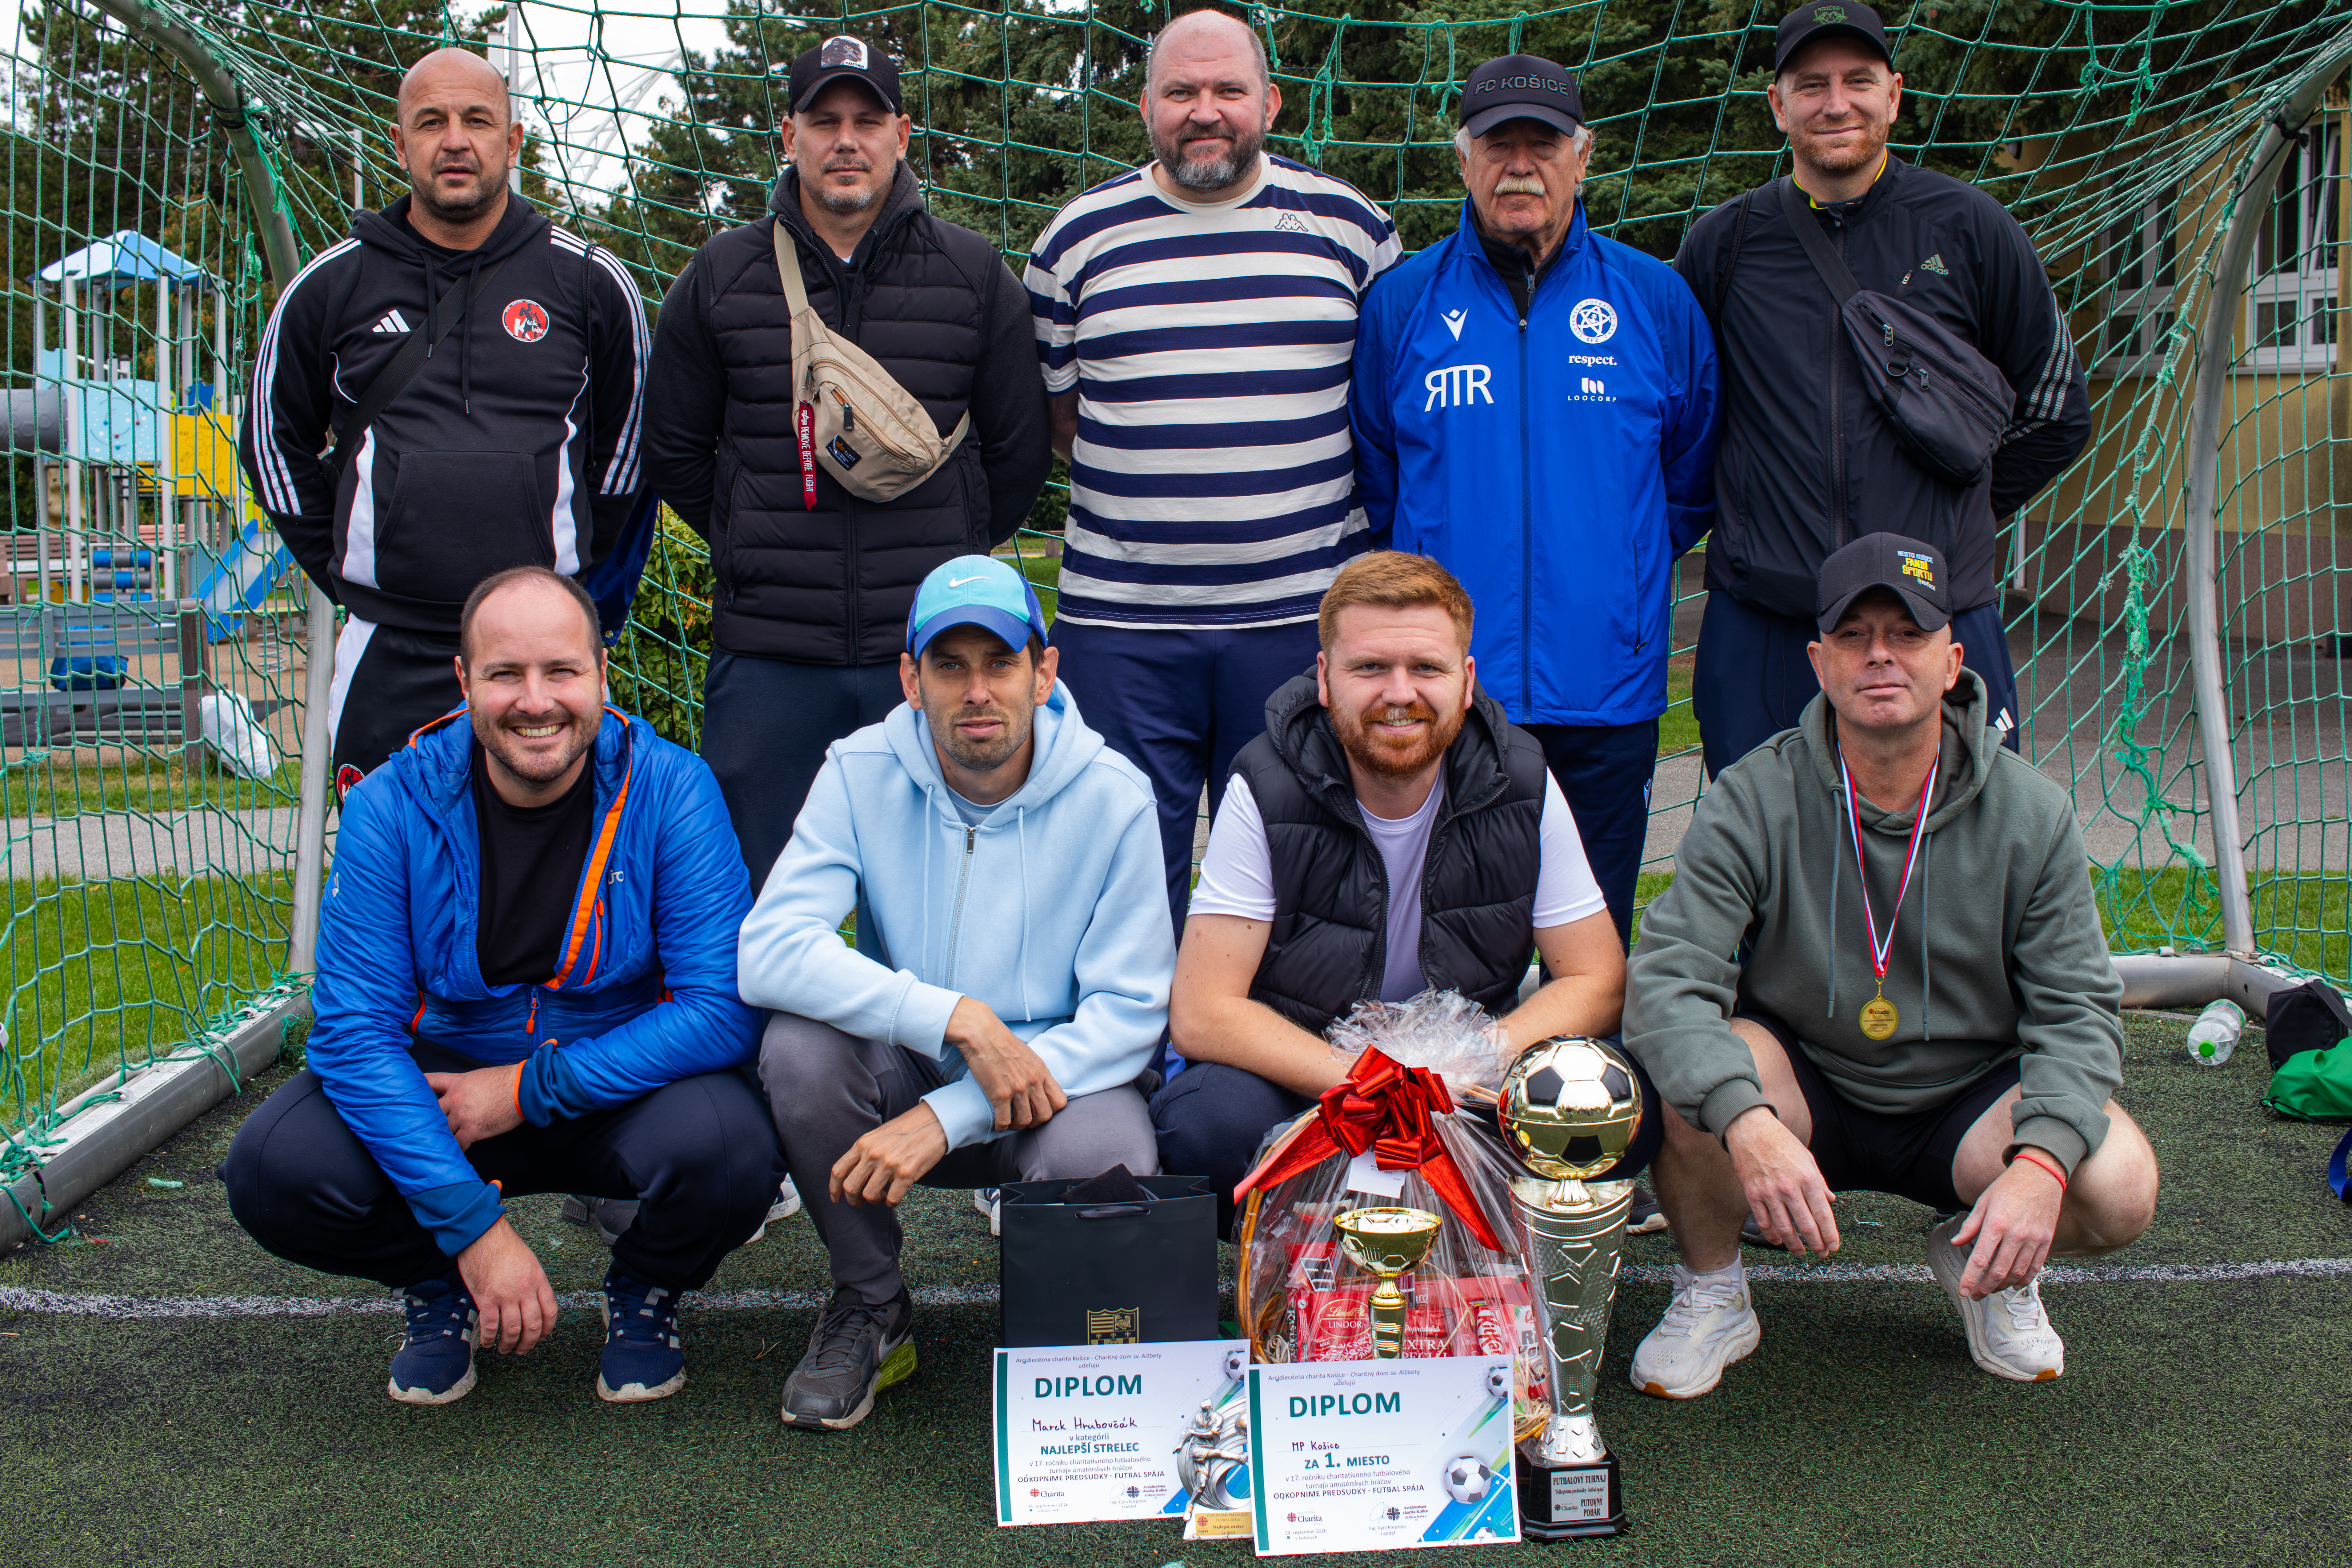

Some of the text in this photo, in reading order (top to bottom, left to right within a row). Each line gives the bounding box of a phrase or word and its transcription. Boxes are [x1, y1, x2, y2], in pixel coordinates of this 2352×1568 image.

[1474, 73, 1568, 96] FC KOŠICE
[1921, 263, 1948, 275] adidas
[532, 325, 543, 334] box
[1568, 355, 1617, 366] respect.
[800, 426, 814, 492] REMOVE BEFORE FLIGHT
[1902, 564, 1933, 581] ŠPORTU
[1326, 1306, 1356, 1317] Lindt
[1287, 1309, 1297, 1358] KAŠTANY
[1405, 1325, 1441, 1334] Popradská
[1403, 1339, 1446, 1350] EXTRA
[1035, 1375, 1141, 1398] DIPLOM
[1290, 1391, 1400, 1417] DIPLOM
[1033, 1416, 1137, 1431] Marek Hrubovčák
[1076, 1433, 1109, 1441] kategórii
[1041, 1442, 1139, 1455] NAJLEPŠÍ STRELEC
[1292, 1440, 1340, 1451] MP Košice
[1304, 1452, 1390, 1469] ZA 1. MIESTO
[1553, 1473, 1606, 1485] FUTBALOVÝ TURNAJ
[1274, 1490, 1320, 1499] ODKOPNIME
[1322, 1488, 1366, 1496] PREDSUDKY
[1402, 1484, 1424, 1492] SPÁJA
[1581, 1495, 1603, 1507] PUTOVNÝ
